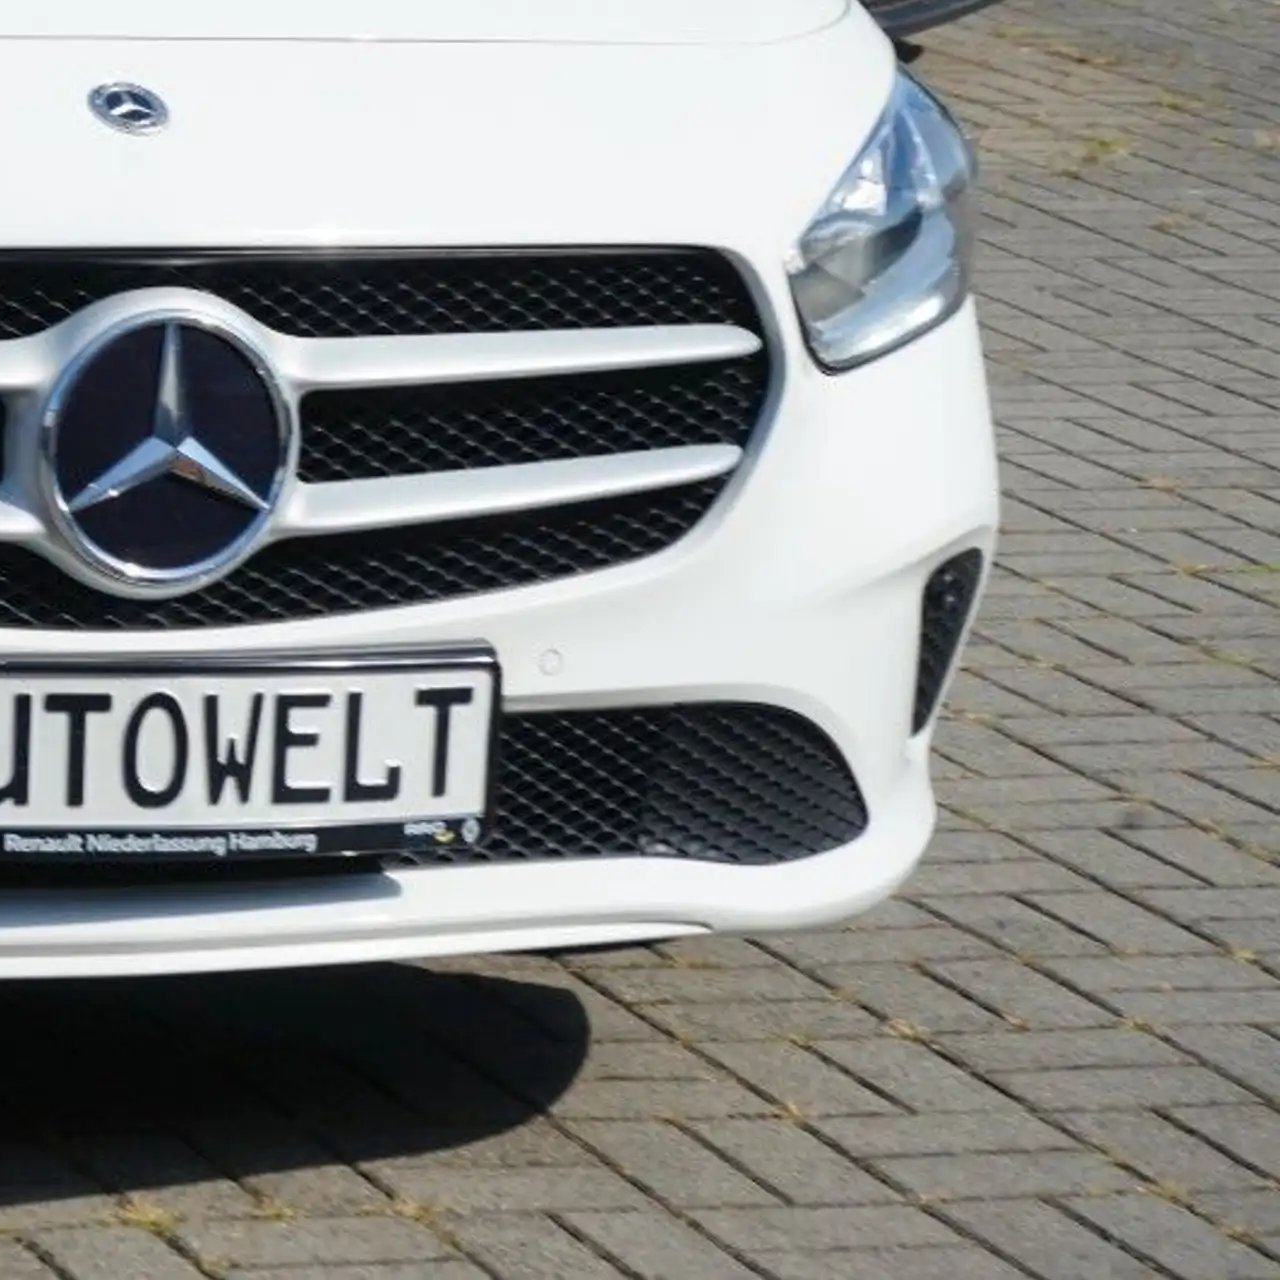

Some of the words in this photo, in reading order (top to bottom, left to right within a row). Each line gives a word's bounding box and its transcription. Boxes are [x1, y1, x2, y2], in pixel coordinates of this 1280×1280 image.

[3, 833, 83, 852] Renault
[86, 833, 227, 857] Niederlassung
[229, 831, 318, 853] Hamburg
